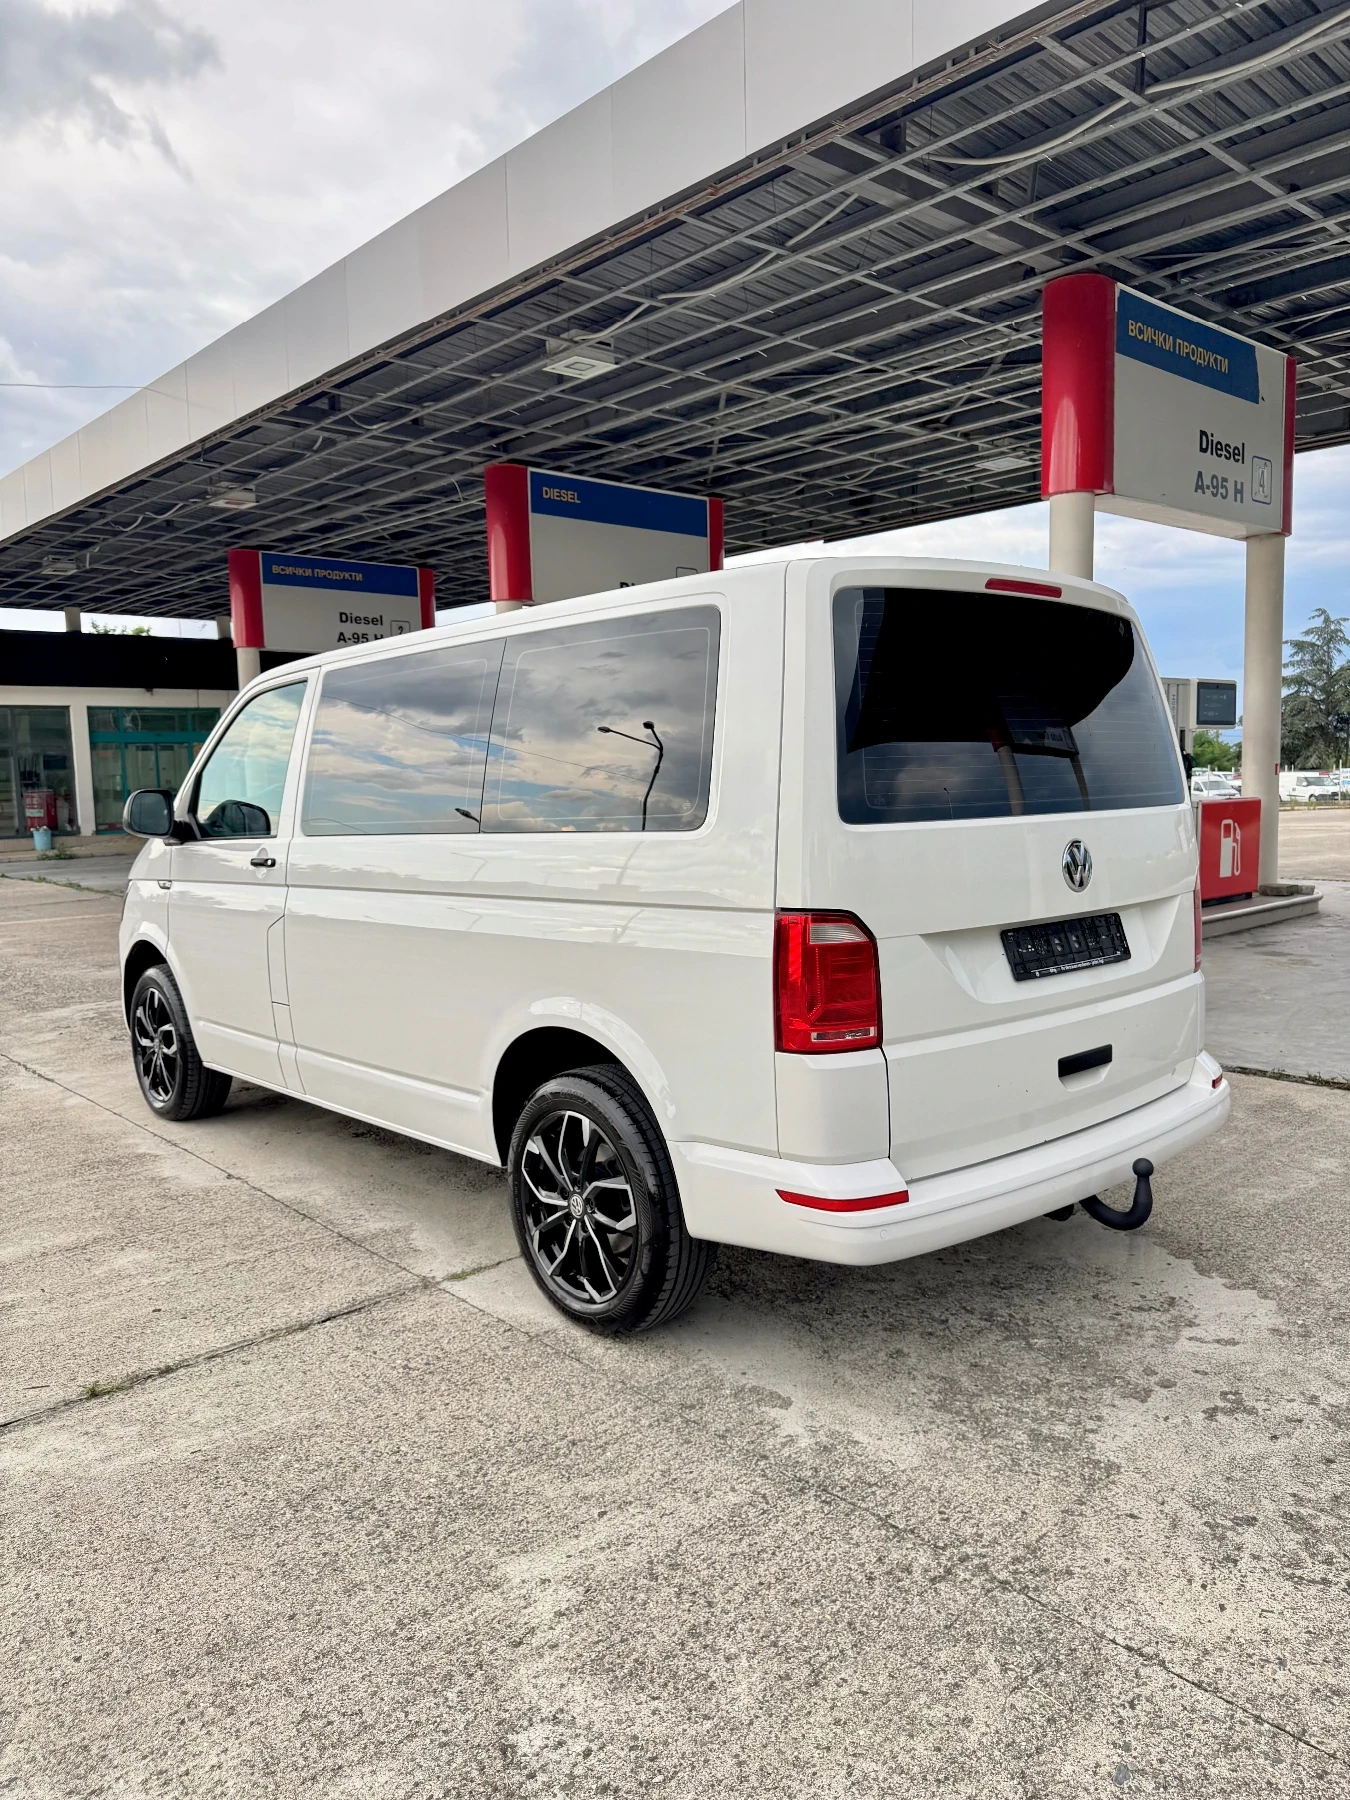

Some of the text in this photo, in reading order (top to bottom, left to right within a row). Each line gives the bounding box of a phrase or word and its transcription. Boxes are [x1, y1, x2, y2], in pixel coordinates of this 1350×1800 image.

[1128, 319, 1229, 374] ВСИЧКИ ПРОДУКТИ
[1199, 429, 1245, 465] Diesel
[1194, 470, 1229, 500] A-95
[542, 486, 581, 503] DIESEL
[272, 565, 363, 581] ВСИЧКИ ПРОДУКТИ
[339, 611, 383, 626] Diesel
[337, 631, 369, 643] A-95
